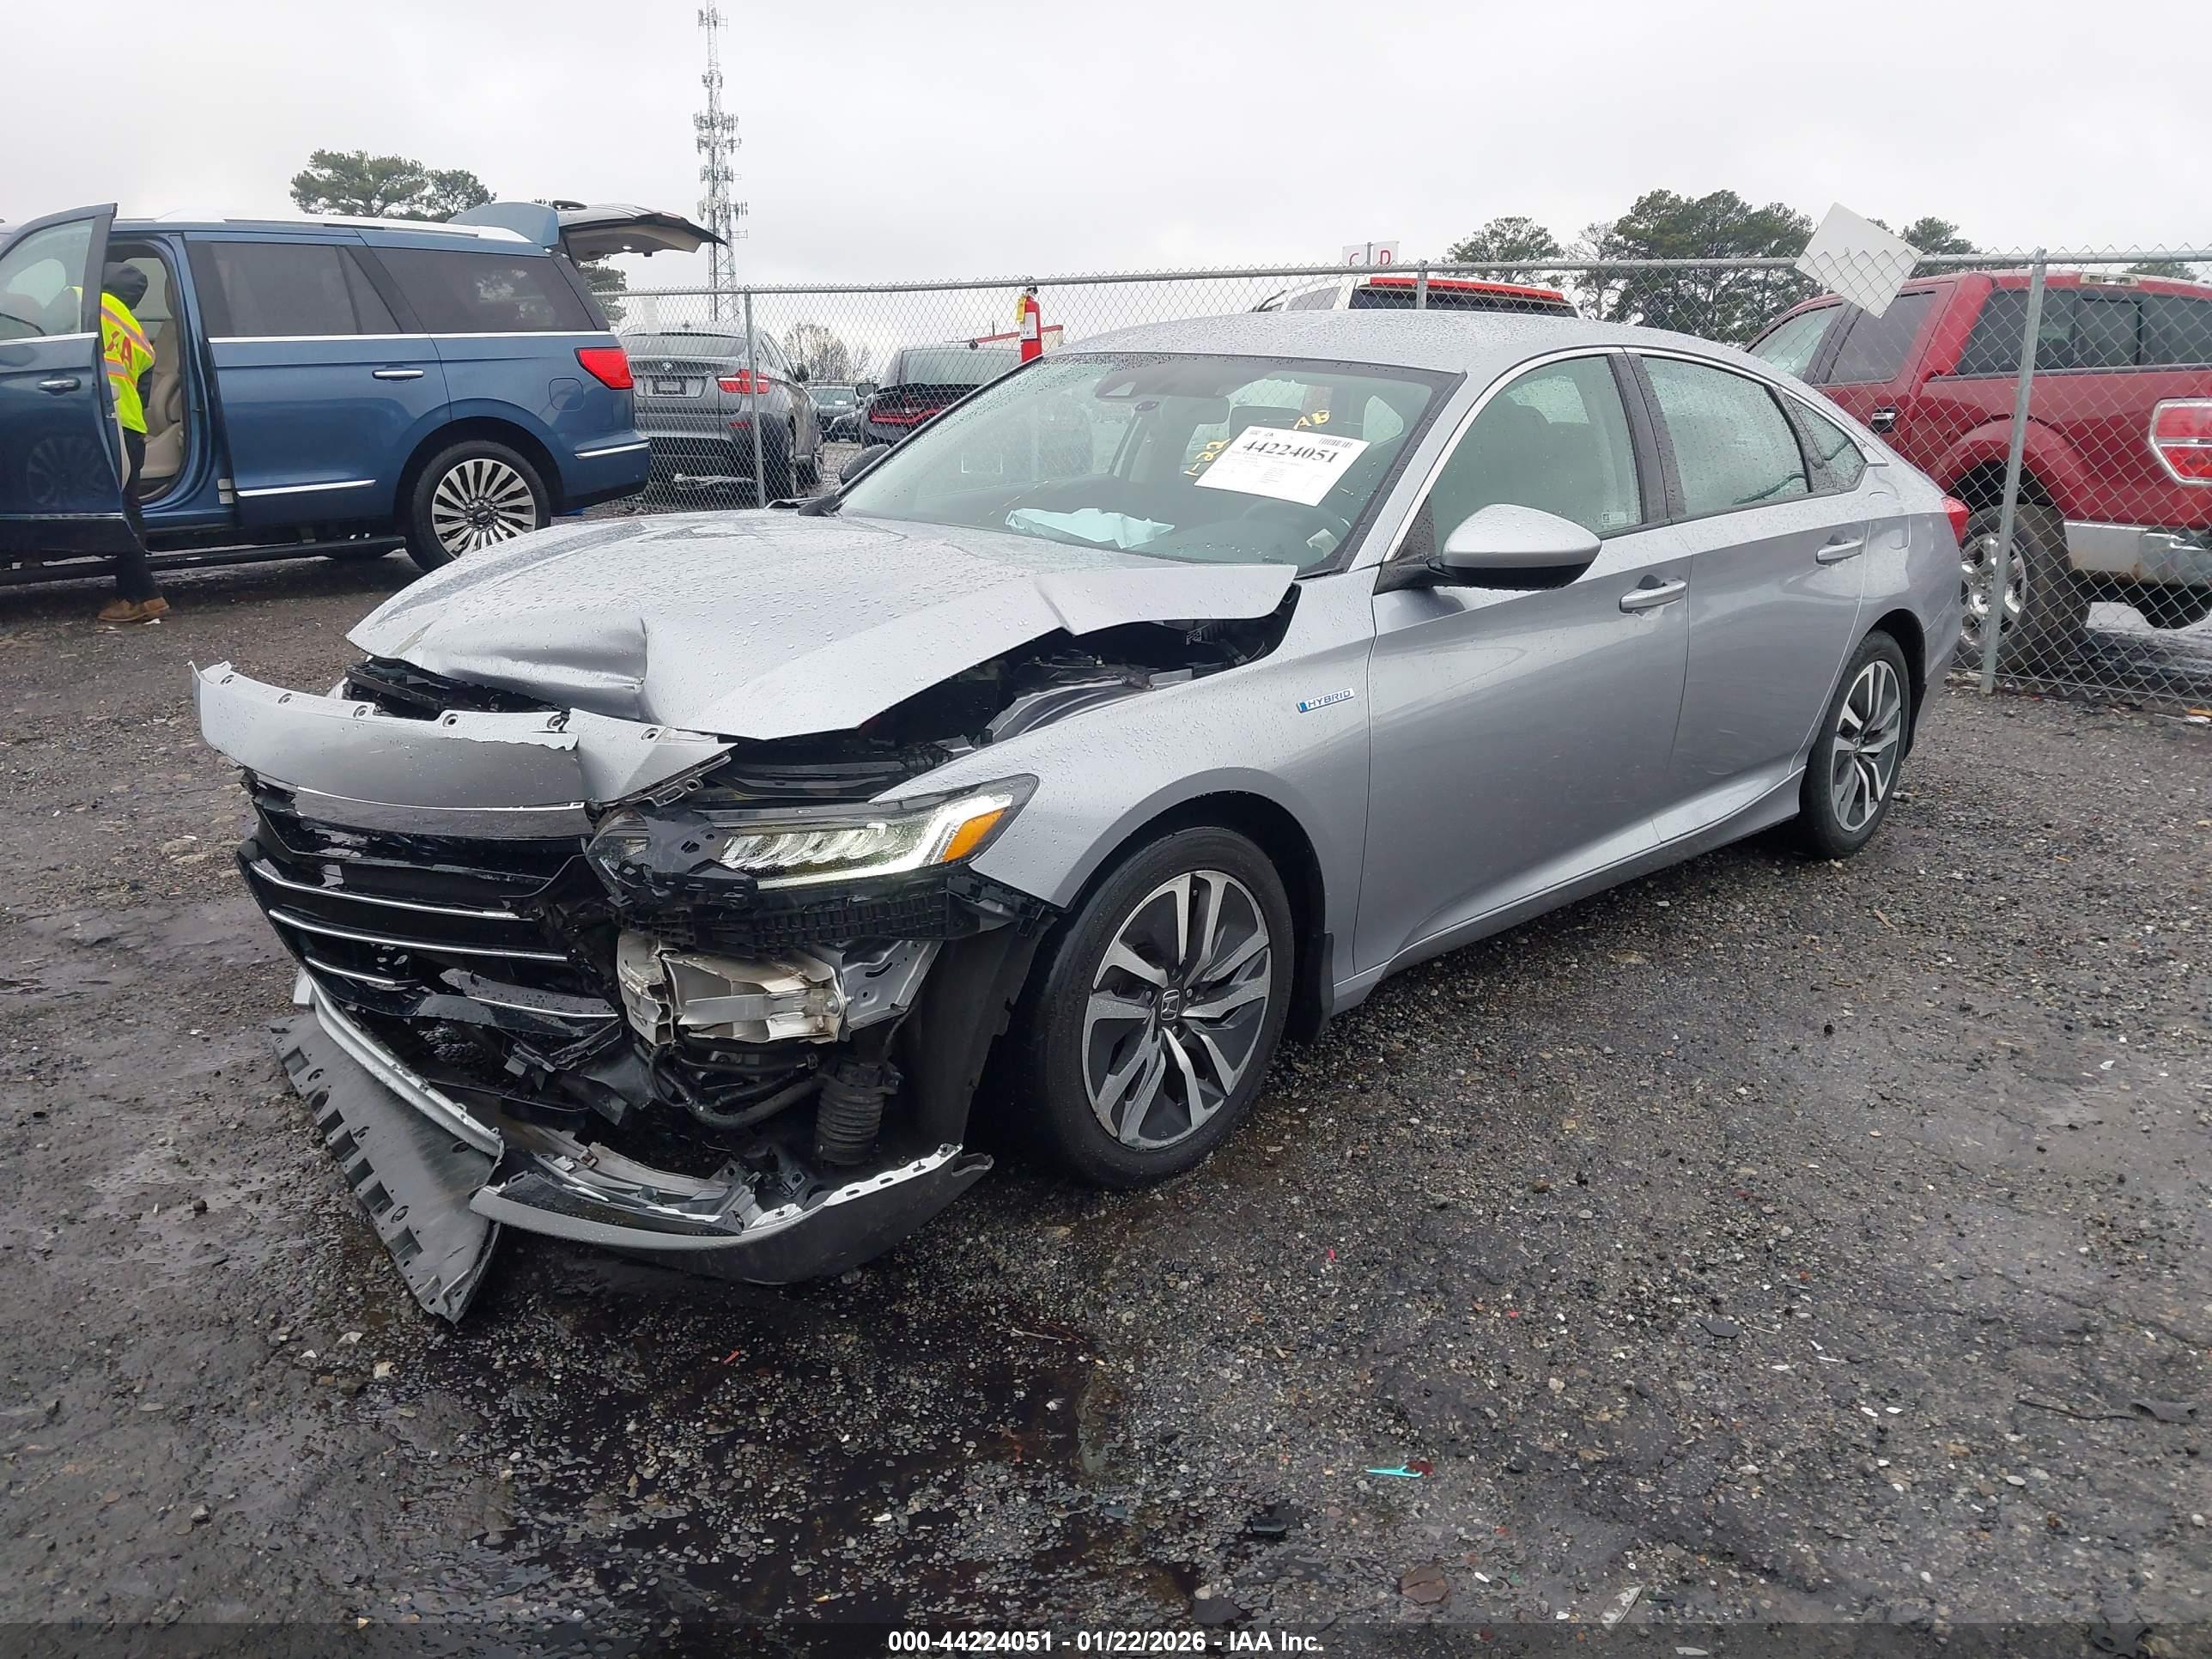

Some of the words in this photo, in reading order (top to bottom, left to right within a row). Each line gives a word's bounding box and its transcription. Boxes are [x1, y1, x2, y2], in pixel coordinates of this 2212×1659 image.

[1380, 249, 1391, 265] D
[1243, 440, 1340, 464] 44224051
[1308, 690, 1351, 708] HYBRID
